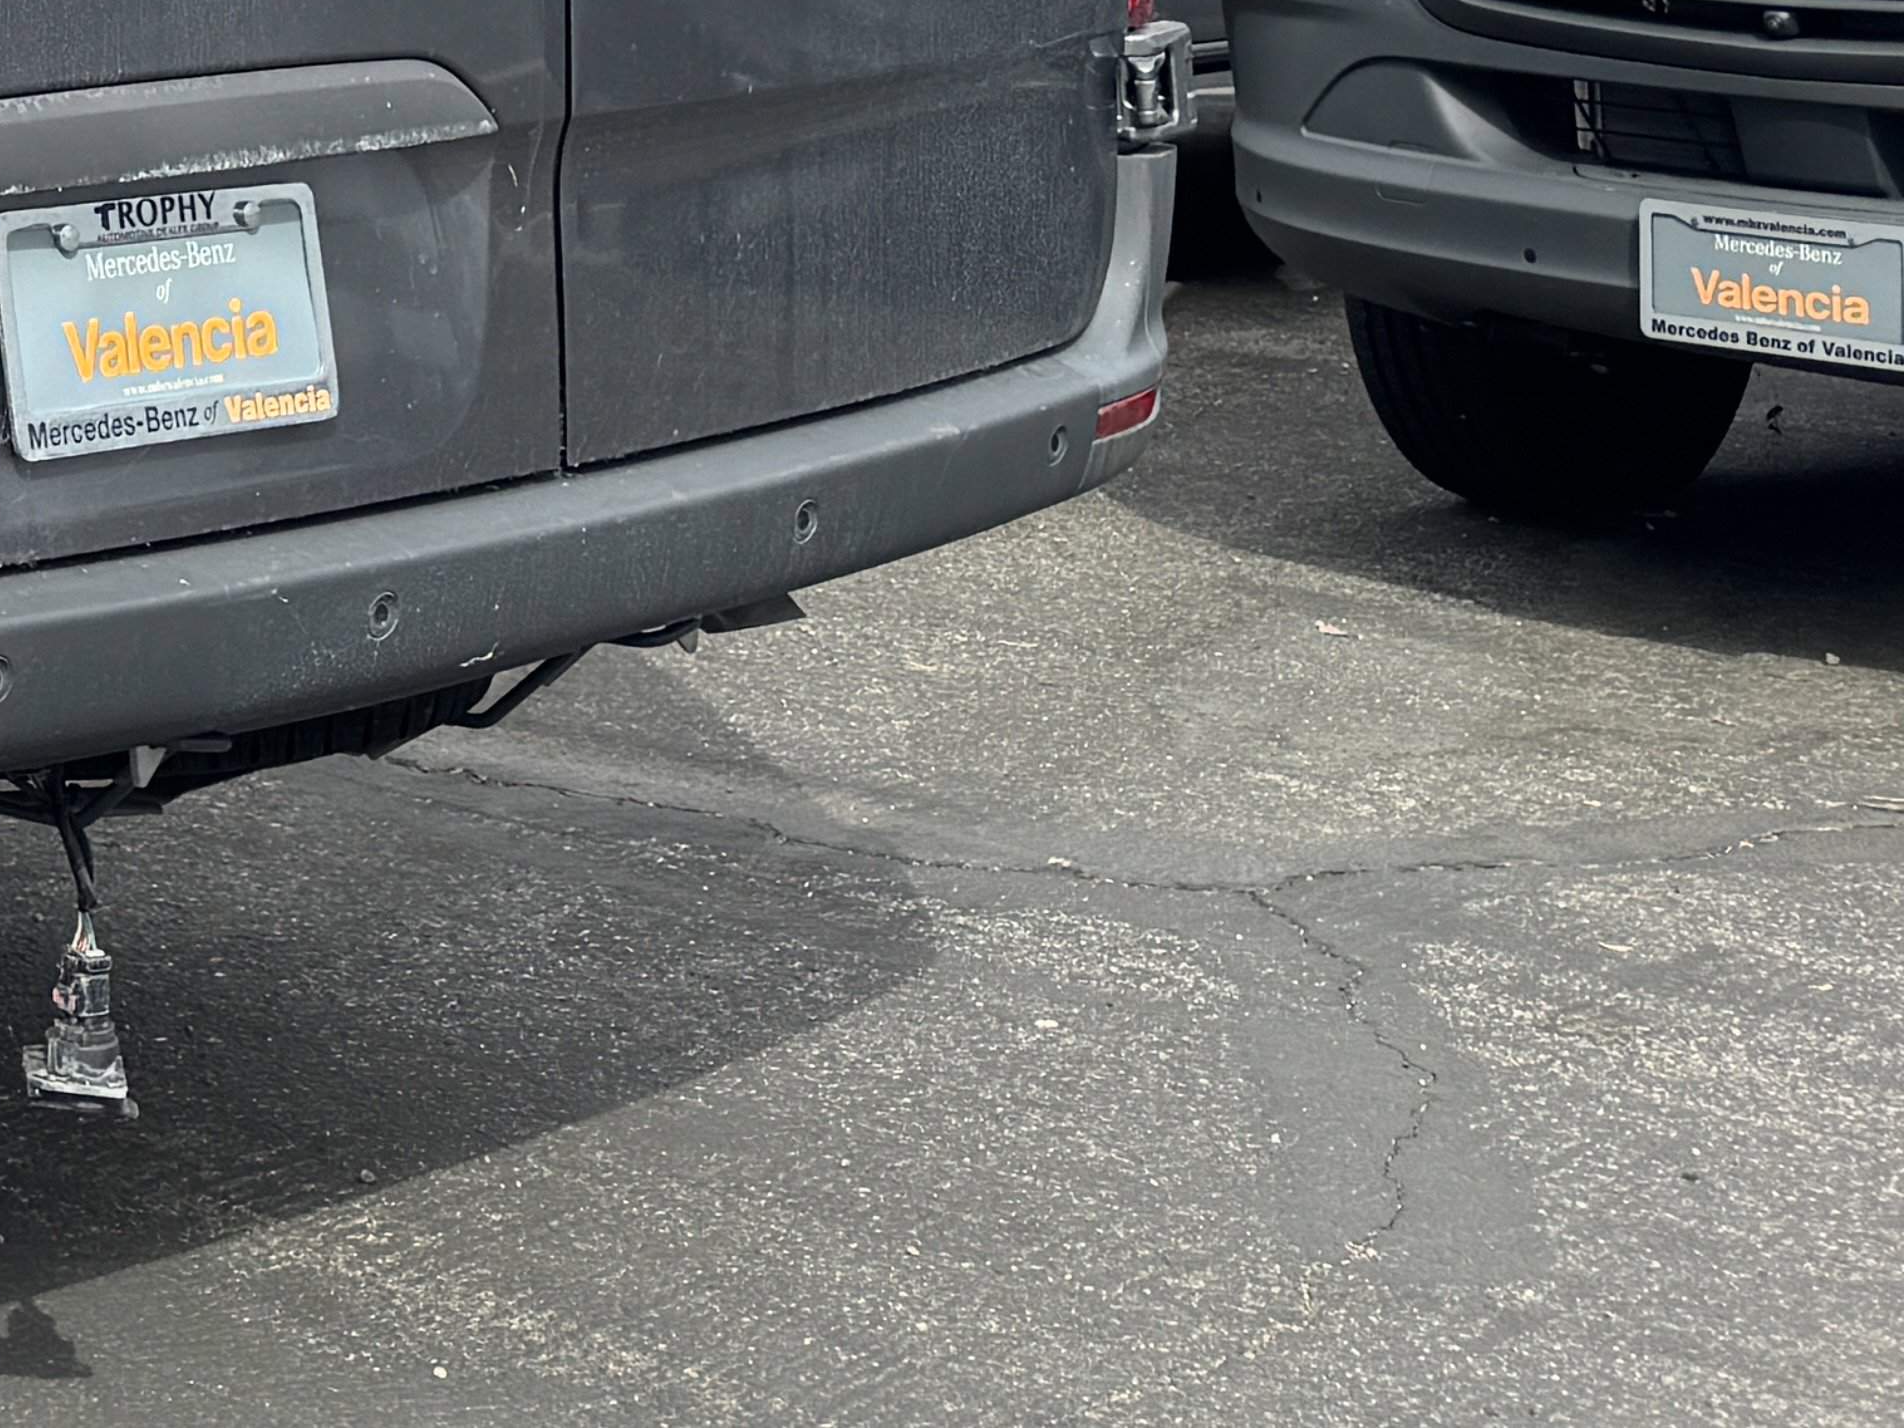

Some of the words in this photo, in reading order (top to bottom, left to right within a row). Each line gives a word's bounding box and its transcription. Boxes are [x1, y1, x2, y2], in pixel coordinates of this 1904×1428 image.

[94, 190, 215, 231] TROPHY
[156, 224, 188, 238] DEALER
[1714, 233, 1842, 265] Mercedes-Benz
[85, 241, 236, 281] Mercedes-Benz
[1769, 261, 1784, 276] of
[156, 278, 172, 304] of
[1691, 267, 1870, 325] Valencia
[61, 296, 279, 383] Valencia
[1652, 318, 1739, 343] Mercedes
[1746, 331, 1791, 351] Benz
[1797, 339, 1816, 354] of
[1822, 340, 1904, 366] Valencia
[28, 405, 199, 451] Mercedes-Benz
[204, 400, 220, 424] of
[224, 385, 332, 424] Valencia
